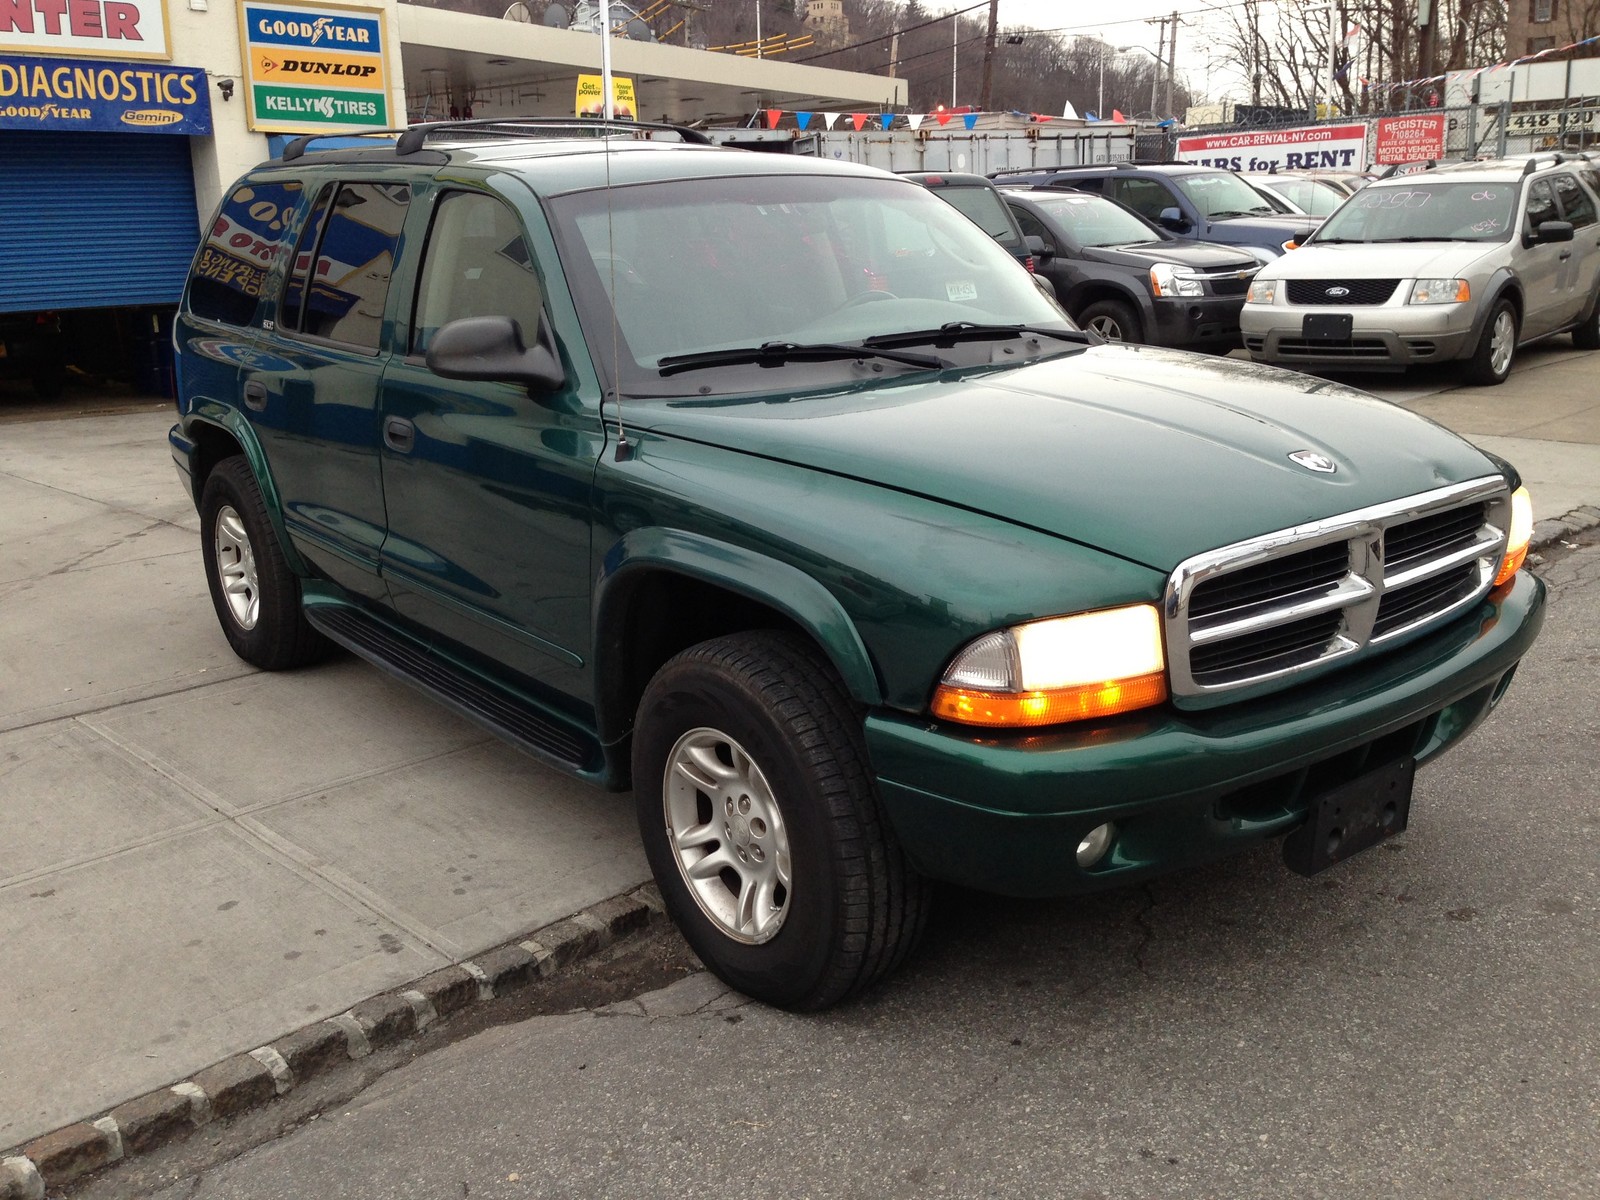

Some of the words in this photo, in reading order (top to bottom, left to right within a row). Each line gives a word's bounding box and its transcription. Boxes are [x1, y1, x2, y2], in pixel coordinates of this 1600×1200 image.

[280, 59, 376, 77] DUNLOP
[0, 63, 197, 105] DIAGNOSTICS
[582, 82, 595, 90] Get
[334, 100, 377, 116] TIRES
[125, 110, 175, 122] Gemini
[1384, 119, 1437, 133] REGISTER
[1205, 130, 1332, 149] www.CAR-RENTAL-NY.com
[1378, 146, 1407, 155] MOTOR
[1407, 144, 1441, 153] VEHICLE
[1379, 154, 1406, 162] RETAIL
[1406, 152, 1438, 161] DEALER
[1248, 157, 1279, 172] for
[1286, 149, 1355, 170] RENT
